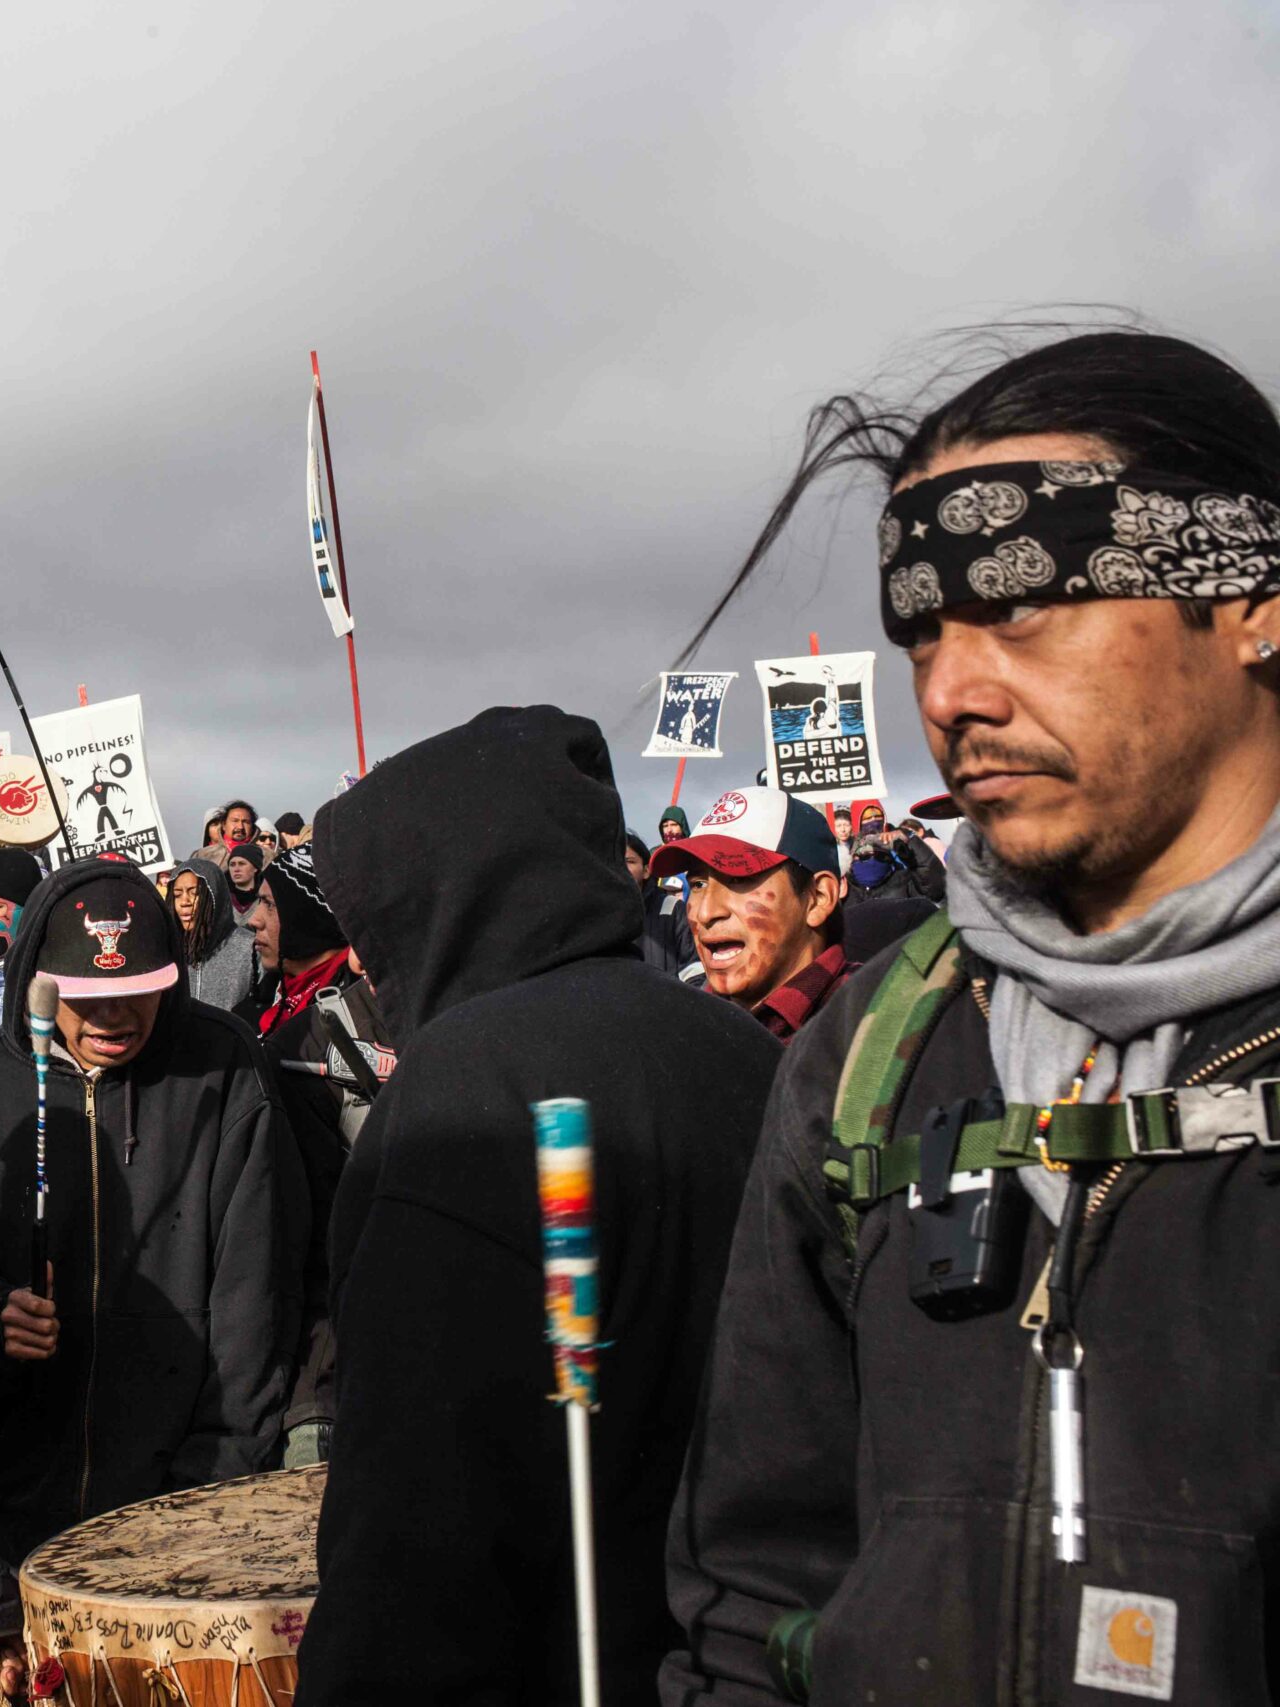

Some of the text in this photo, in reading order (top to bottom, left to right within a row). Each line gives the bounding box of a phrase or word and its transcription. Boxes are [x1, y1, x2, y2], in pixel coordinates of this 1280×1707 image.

[666, 688, 722, 704] WATER
[44, 734, 135, 765] NO PIPELINES!
[778, 736, 864, 759] DEFEND
[809, 756, 837, 767] THE
[782, 765, 867, 787] SACRED
[129, 830, 156, 846] THE
